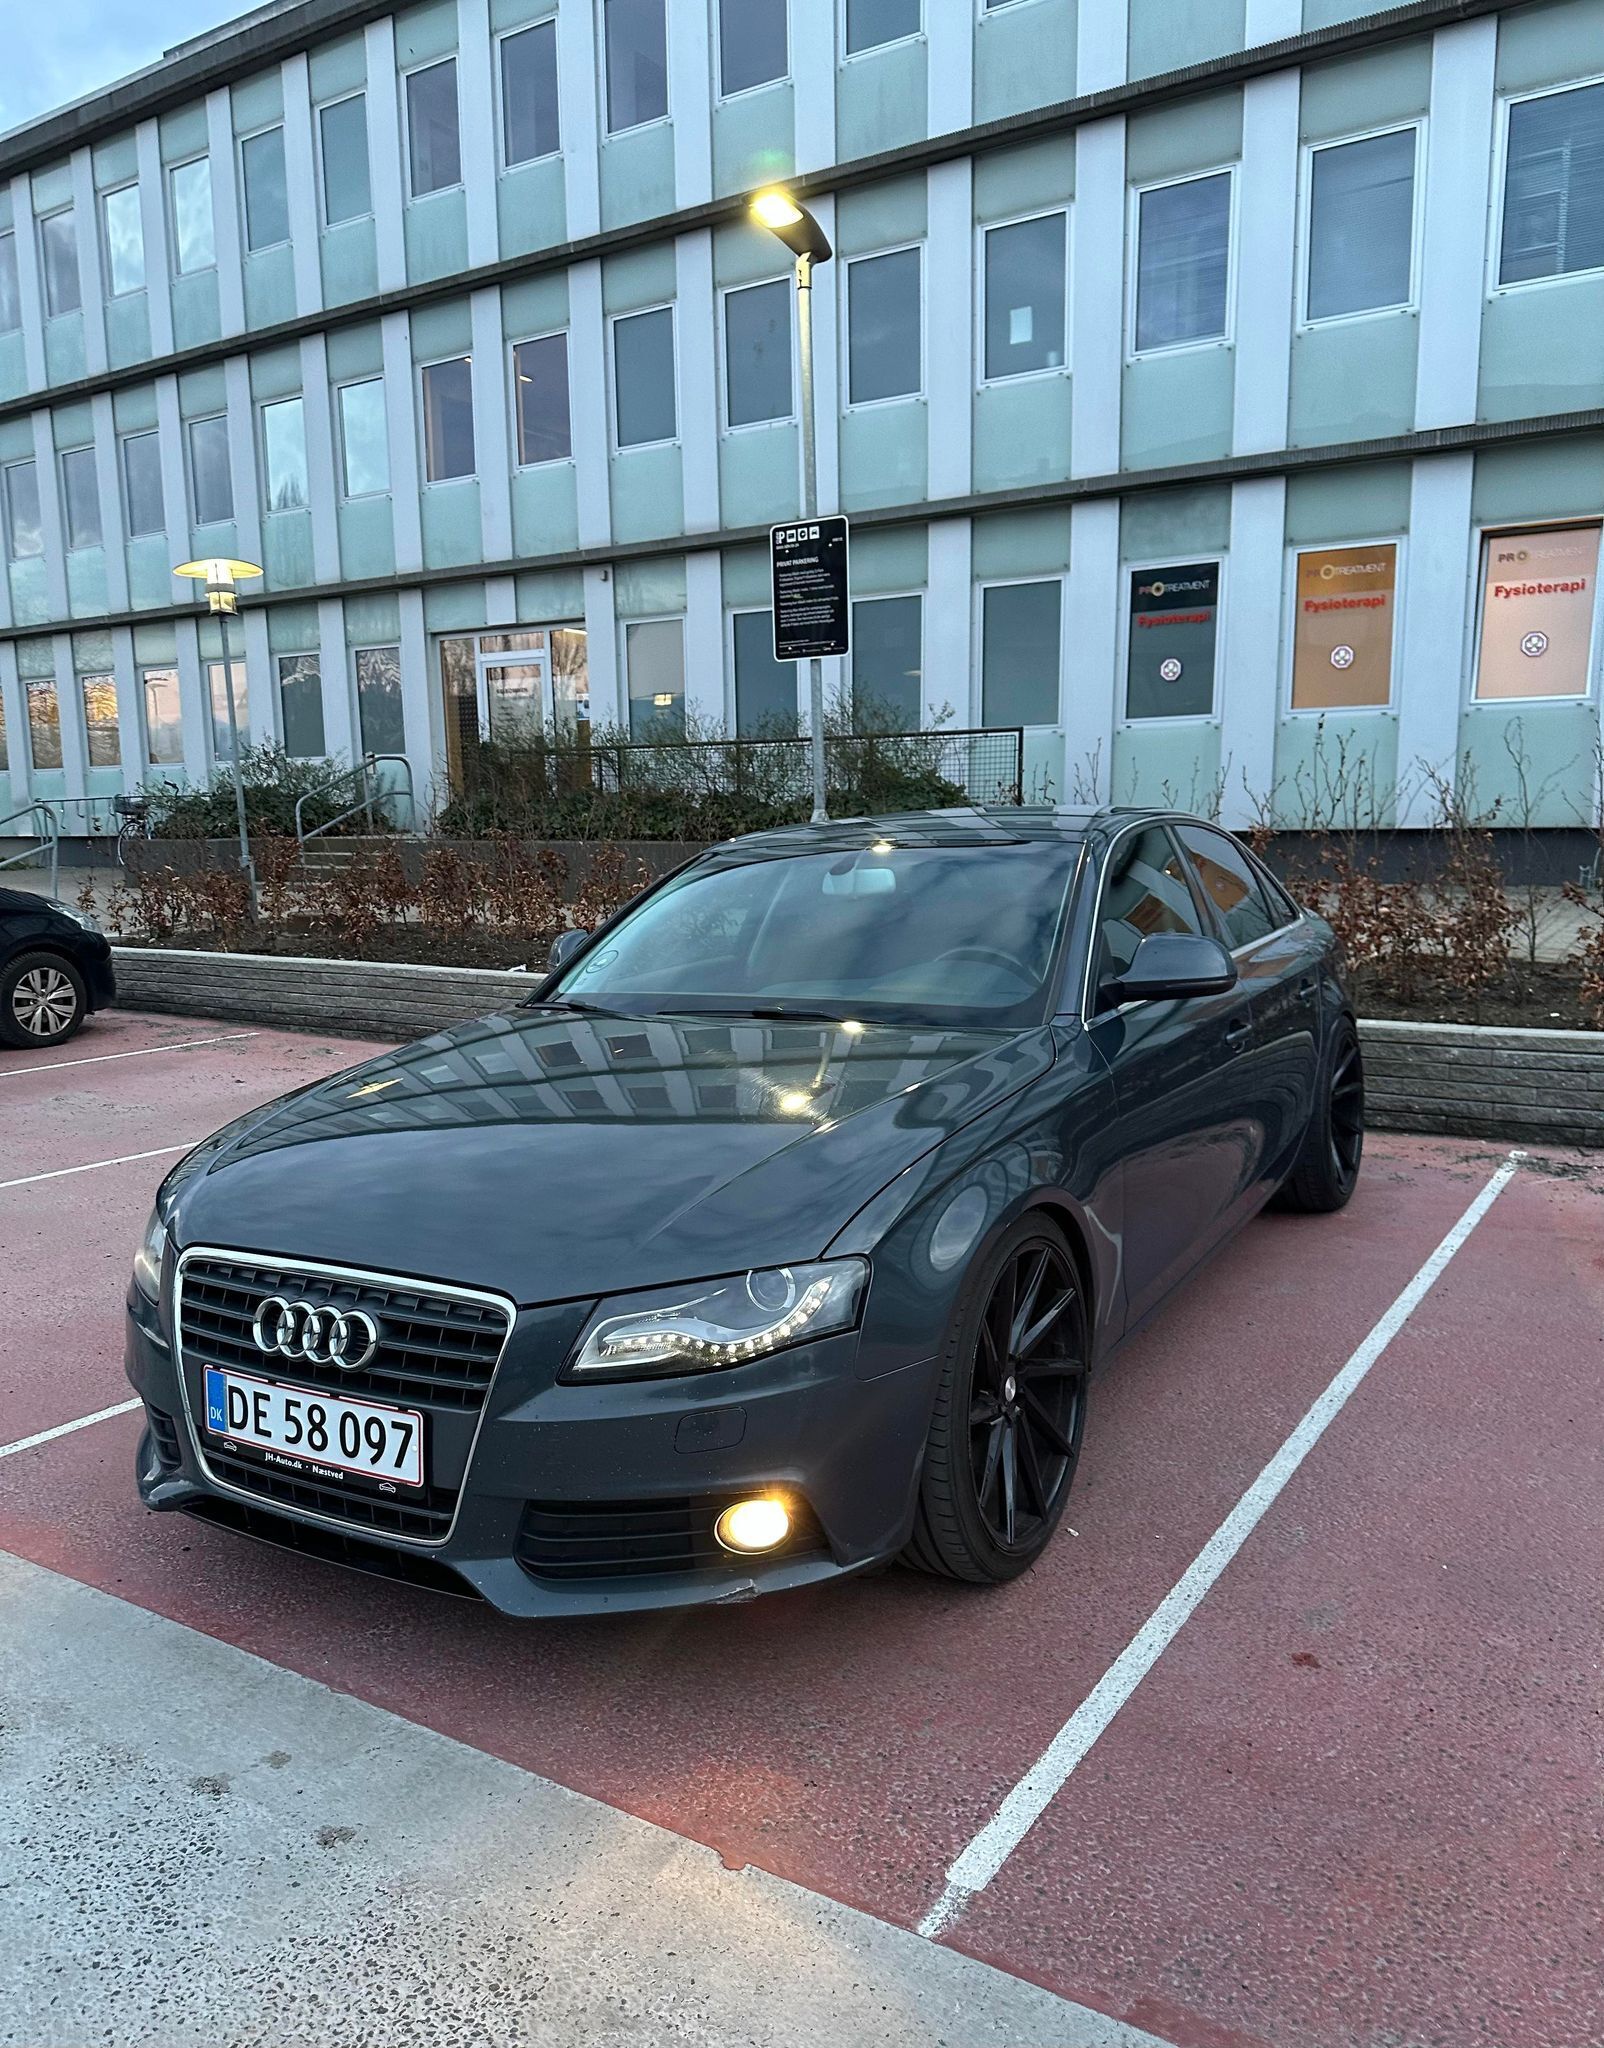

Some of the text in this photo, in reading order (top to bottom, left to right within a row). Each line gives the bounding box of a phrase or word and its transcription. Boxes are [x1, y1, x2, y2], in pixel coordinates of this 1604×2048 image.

[1494, 578, 1586, 599] Fysioterapi
[1304, 594, 1386, 613] Fysioterapi
[1138, 609, 1211, 629] Fysioterapi
[210, 1406, 223, 1422] DK
[228, 1385, 413, 1469] DE 58 097
[264, 1452, 344, 1480] JH-Auto.dk Næstved
